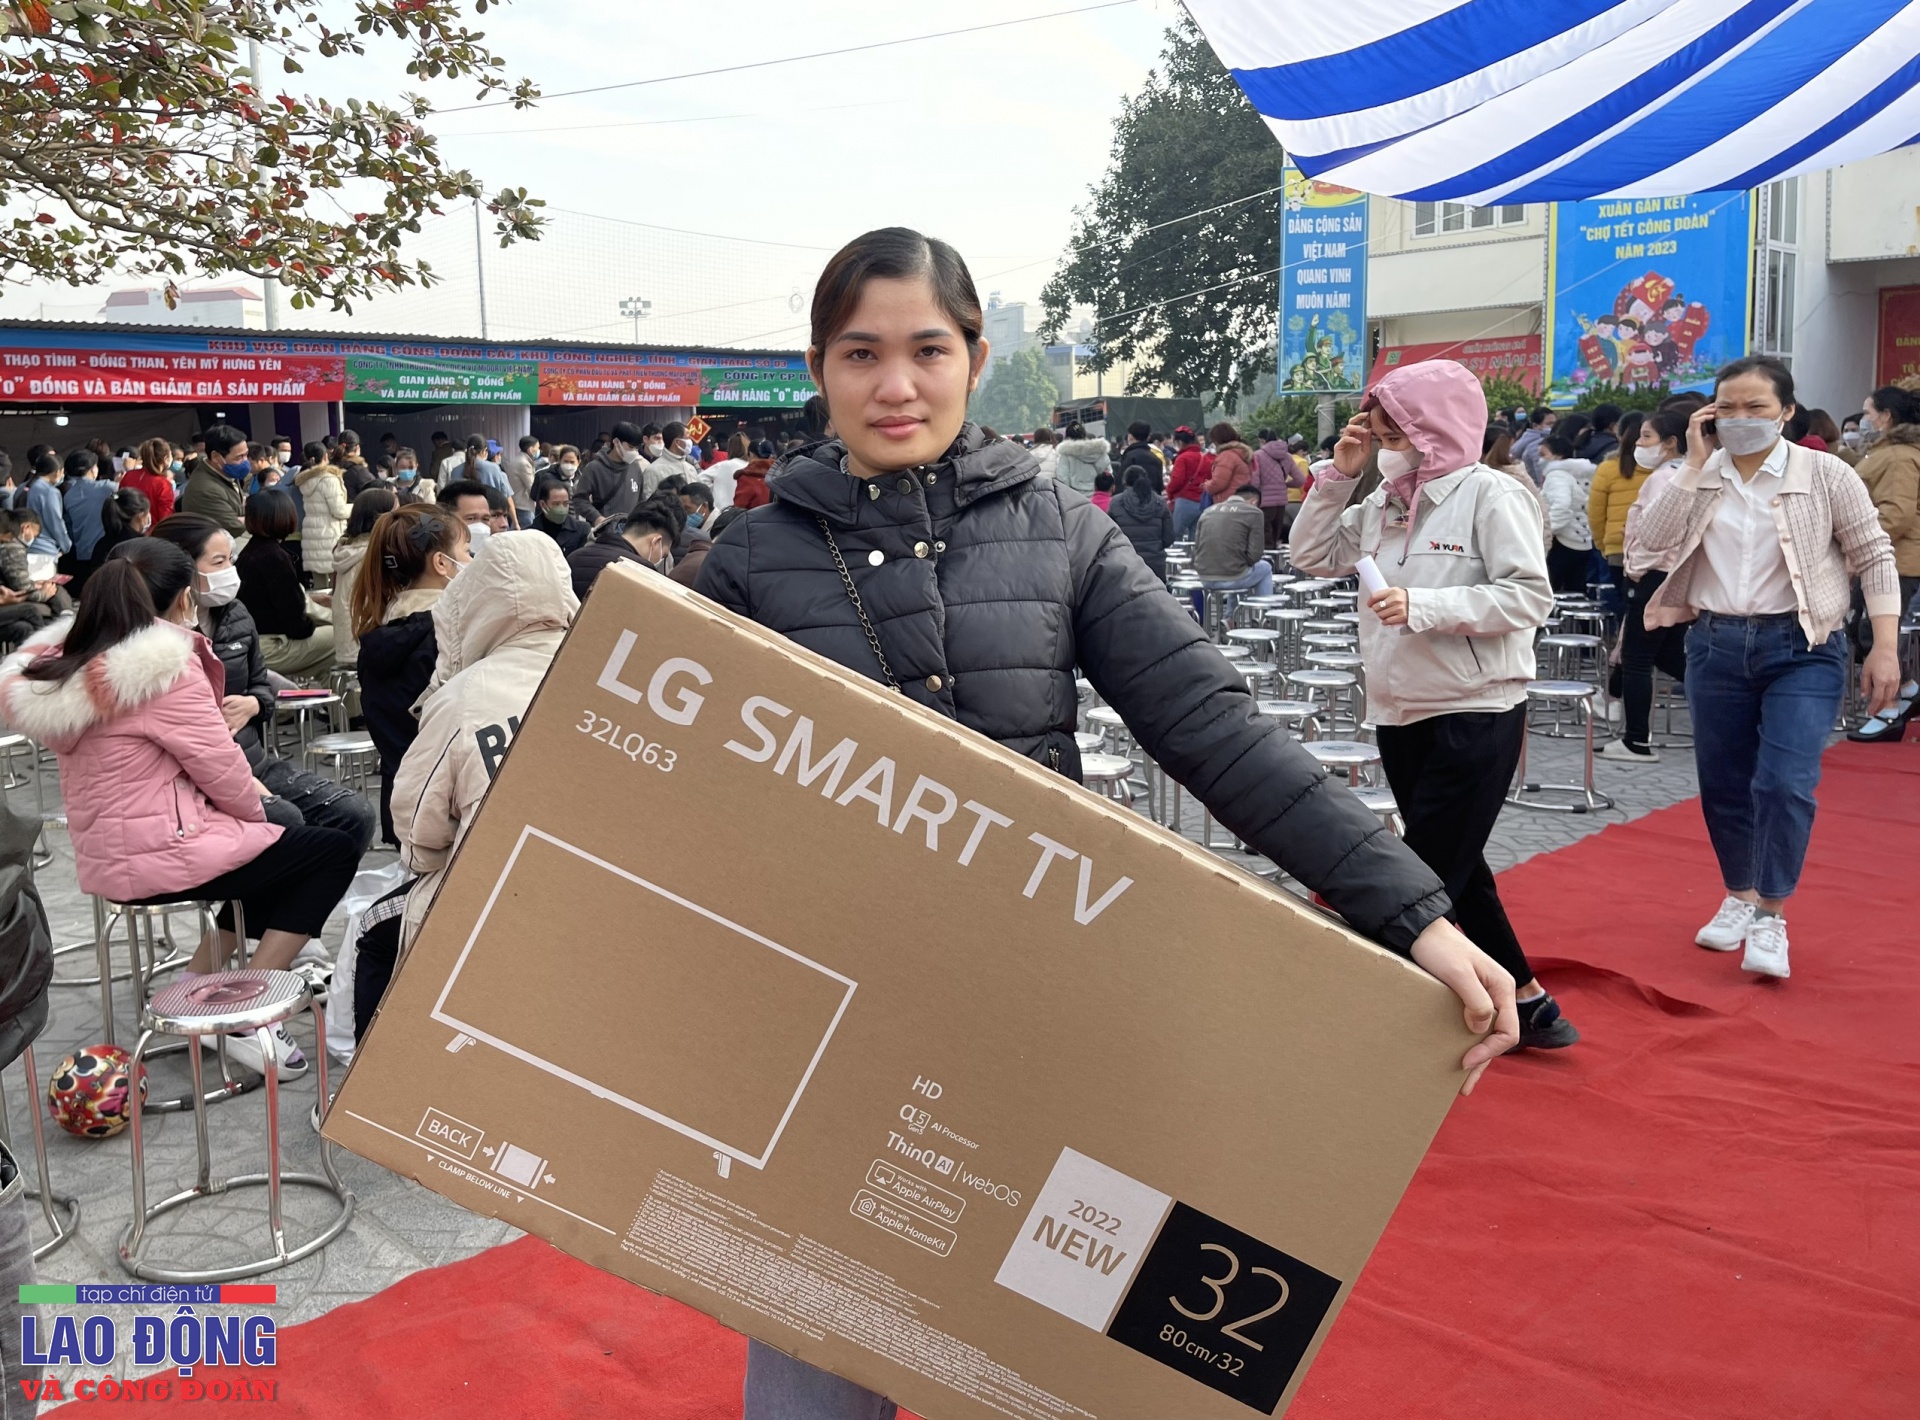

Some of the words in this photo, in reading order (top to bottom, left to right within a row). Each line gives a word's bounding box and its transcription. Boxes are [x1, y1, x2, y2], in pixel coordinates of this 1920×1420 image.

[1598, 200, 1632, 218] XUÂN
[1288, 214, 1313, 234] ĐẢNG
[1315, 214, 1340, 236] CỘNG
[1343, 211, 1362, 232] SẢN
[1614, 219, 1635, 238] TẾT
[1637, 218, 1671, 235] CÔNG
[1303, 240, 1323, 262] VIỆT
[1324, 242, 1346, 258] NAM
[1615, 242, 1644, 260] NĂM
[1647, 240, 1677, 256] 2023
[1296, 268, 1328, 286] QUANG
[1330, 268, 1351, 283] VINH
[1296, 290, 1323, 310] MUÔN
[1325, 290, 1351, 308] NĂM!
[89, 352, 127, 368] ĐỒNG
[130, 356, 169, 370] THAN,
[172, 356, 197, 369] YÊN
[200, 357, 219, 370] MỸ
[222, 359, 255, 371] HƯNG
[258, 357, 282, 371] YÊN
[208, 340, 247, 352] KHU
[292, 343, 336, 354] GIAN
[340, 342, 386, 356] HÀNG
[391, 344, 435, 358] CÔNG
[439, 347, 482, 359] ĐOÀN
[486, 348, 515, 360] CÁC
[520, 350, 549, 361] KHU
[553, 350, 591, 363] CÔNG
[595, 352, 643, 366] NGHIỆP
[688, 357, 717, 367] GIAN
[720, 358, 753, 368] HÀNG
[755, 359, 770, 368] SỐ
[30, 375, 79, 395] ĐỒNG
[83, 378, 107, 395] VÀ
[110, 379, 146, 395] BÁN
[150, 377, 192, 396] GIẢM
[196, 379, 223, 396] GIÁ
[227, 378, 259, 396] SẢN
[262, 377, 306, 396] PHẨM
[399, 376, 424, 385] GIAN
[427, 375, 455, 386] HÀNG
[477, 375, 504, 387] ĐỒNG
[578, 380, 600, 389] GIAN
[601, 379, 625, 390] HÀNG
[643, 379, 666, 390] ĐỒNG
[724, 371, 758, 381] CÔNG
[762, 373, 776, 381] TY
[779, 373, 796, 381] CP
[381, 388, 395, 398] VÀ
[397, 389, 419, 399] BÁN
[422, 388, 449, 399] GIẢM
[451, 389, 469, 400] GIÁ
[471, 389, 492, 400] SẢN
[494, 388, 522, 400] PHẨM
[563, 392, 575, 401] VÀ
[576, 393, 595, 401] BÁN
[597, 392, 620, 402] GIẢM
[621, 393, 636, 402] GIÁ
[637, 392, 655, 402] SẢN
[713, 389, 736, 401] GIAN
[742, 388, 771, 402] HÀNG
[575, 709, 679, 774] 32LQ63
[596, 628, 714, 726] LG
[723, 695, 1015, 867] SMART
[1022, 831, 1135, 926] TV
[911, 1075, 943, 1100] HD
[427, 1118, 473, 1148] BACK
[931, 1122, 942, 1132] AI
[942, 1127, 980, 1150] Processor
[438, 1160, 465, 1177] CLAMP
[465, 1173, 494, 1191] BELOW
[493, 1186, 512, 1199] LINE
[886, 1130, 936, 1169] ThinQ
[962, 1170, 1022, 1207] webOS
[897, 1174, 915, 1187] Works
[915, 1183, 928, 1193] with
[892, 1182, 921, 1203] Apple
[921, 1196, 956, 1219] AirPlay
[880, 1203, 897, 1217] Works
[897, 1213, 910, 1222] with
[1067, 1199, 1122, 1236] 2022
[875, 1210, 904, 1232] Apple
[904, 1224, 946, 1251] HomeKit
[1032, 1215, 1127, 1277] NEW
[1169, 1243, 1290, 1352] 32
[1159, 1324, 1245, 1377] 80cm/32
